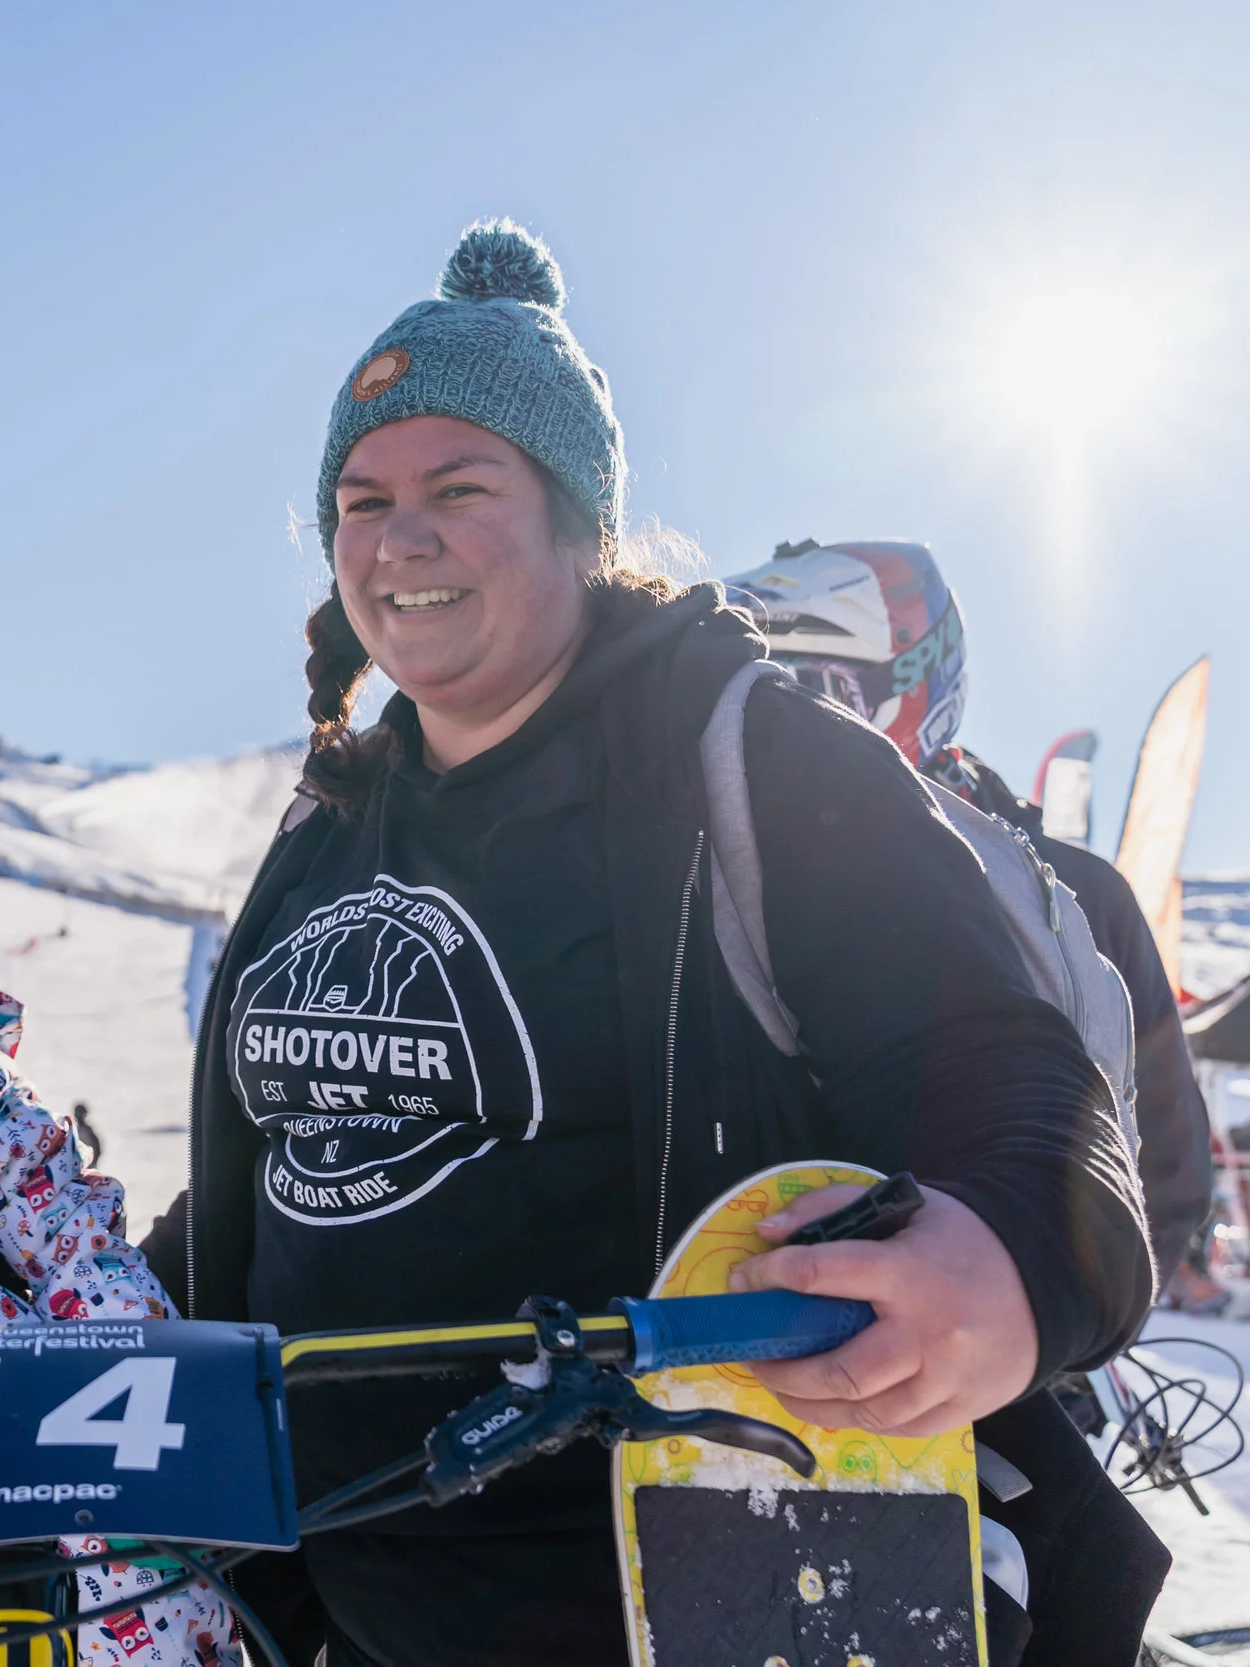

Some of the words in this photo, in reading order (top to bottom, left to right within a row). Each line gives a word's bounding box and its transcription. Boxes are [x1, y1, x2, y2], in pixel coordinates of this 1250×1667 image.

[290, 903, 369, 952] WORLDS
[369, 887, 415, 913] OST
[405, 902, 465, 956] EXCITING
[244, 1024, 453, 1081] SHOTOVER
[261, 1080, 288, 1103] EST
[307, 1081, 369, 1111] JET
[388, 1093, 440, 1115] 1965
[321, 1140, 340, 1164] NZ
[272, 1164, 293, 1197] JET
[293, 1180, 343, 1208] BOAT
[342, 1171, 398, 1206] RIDE
